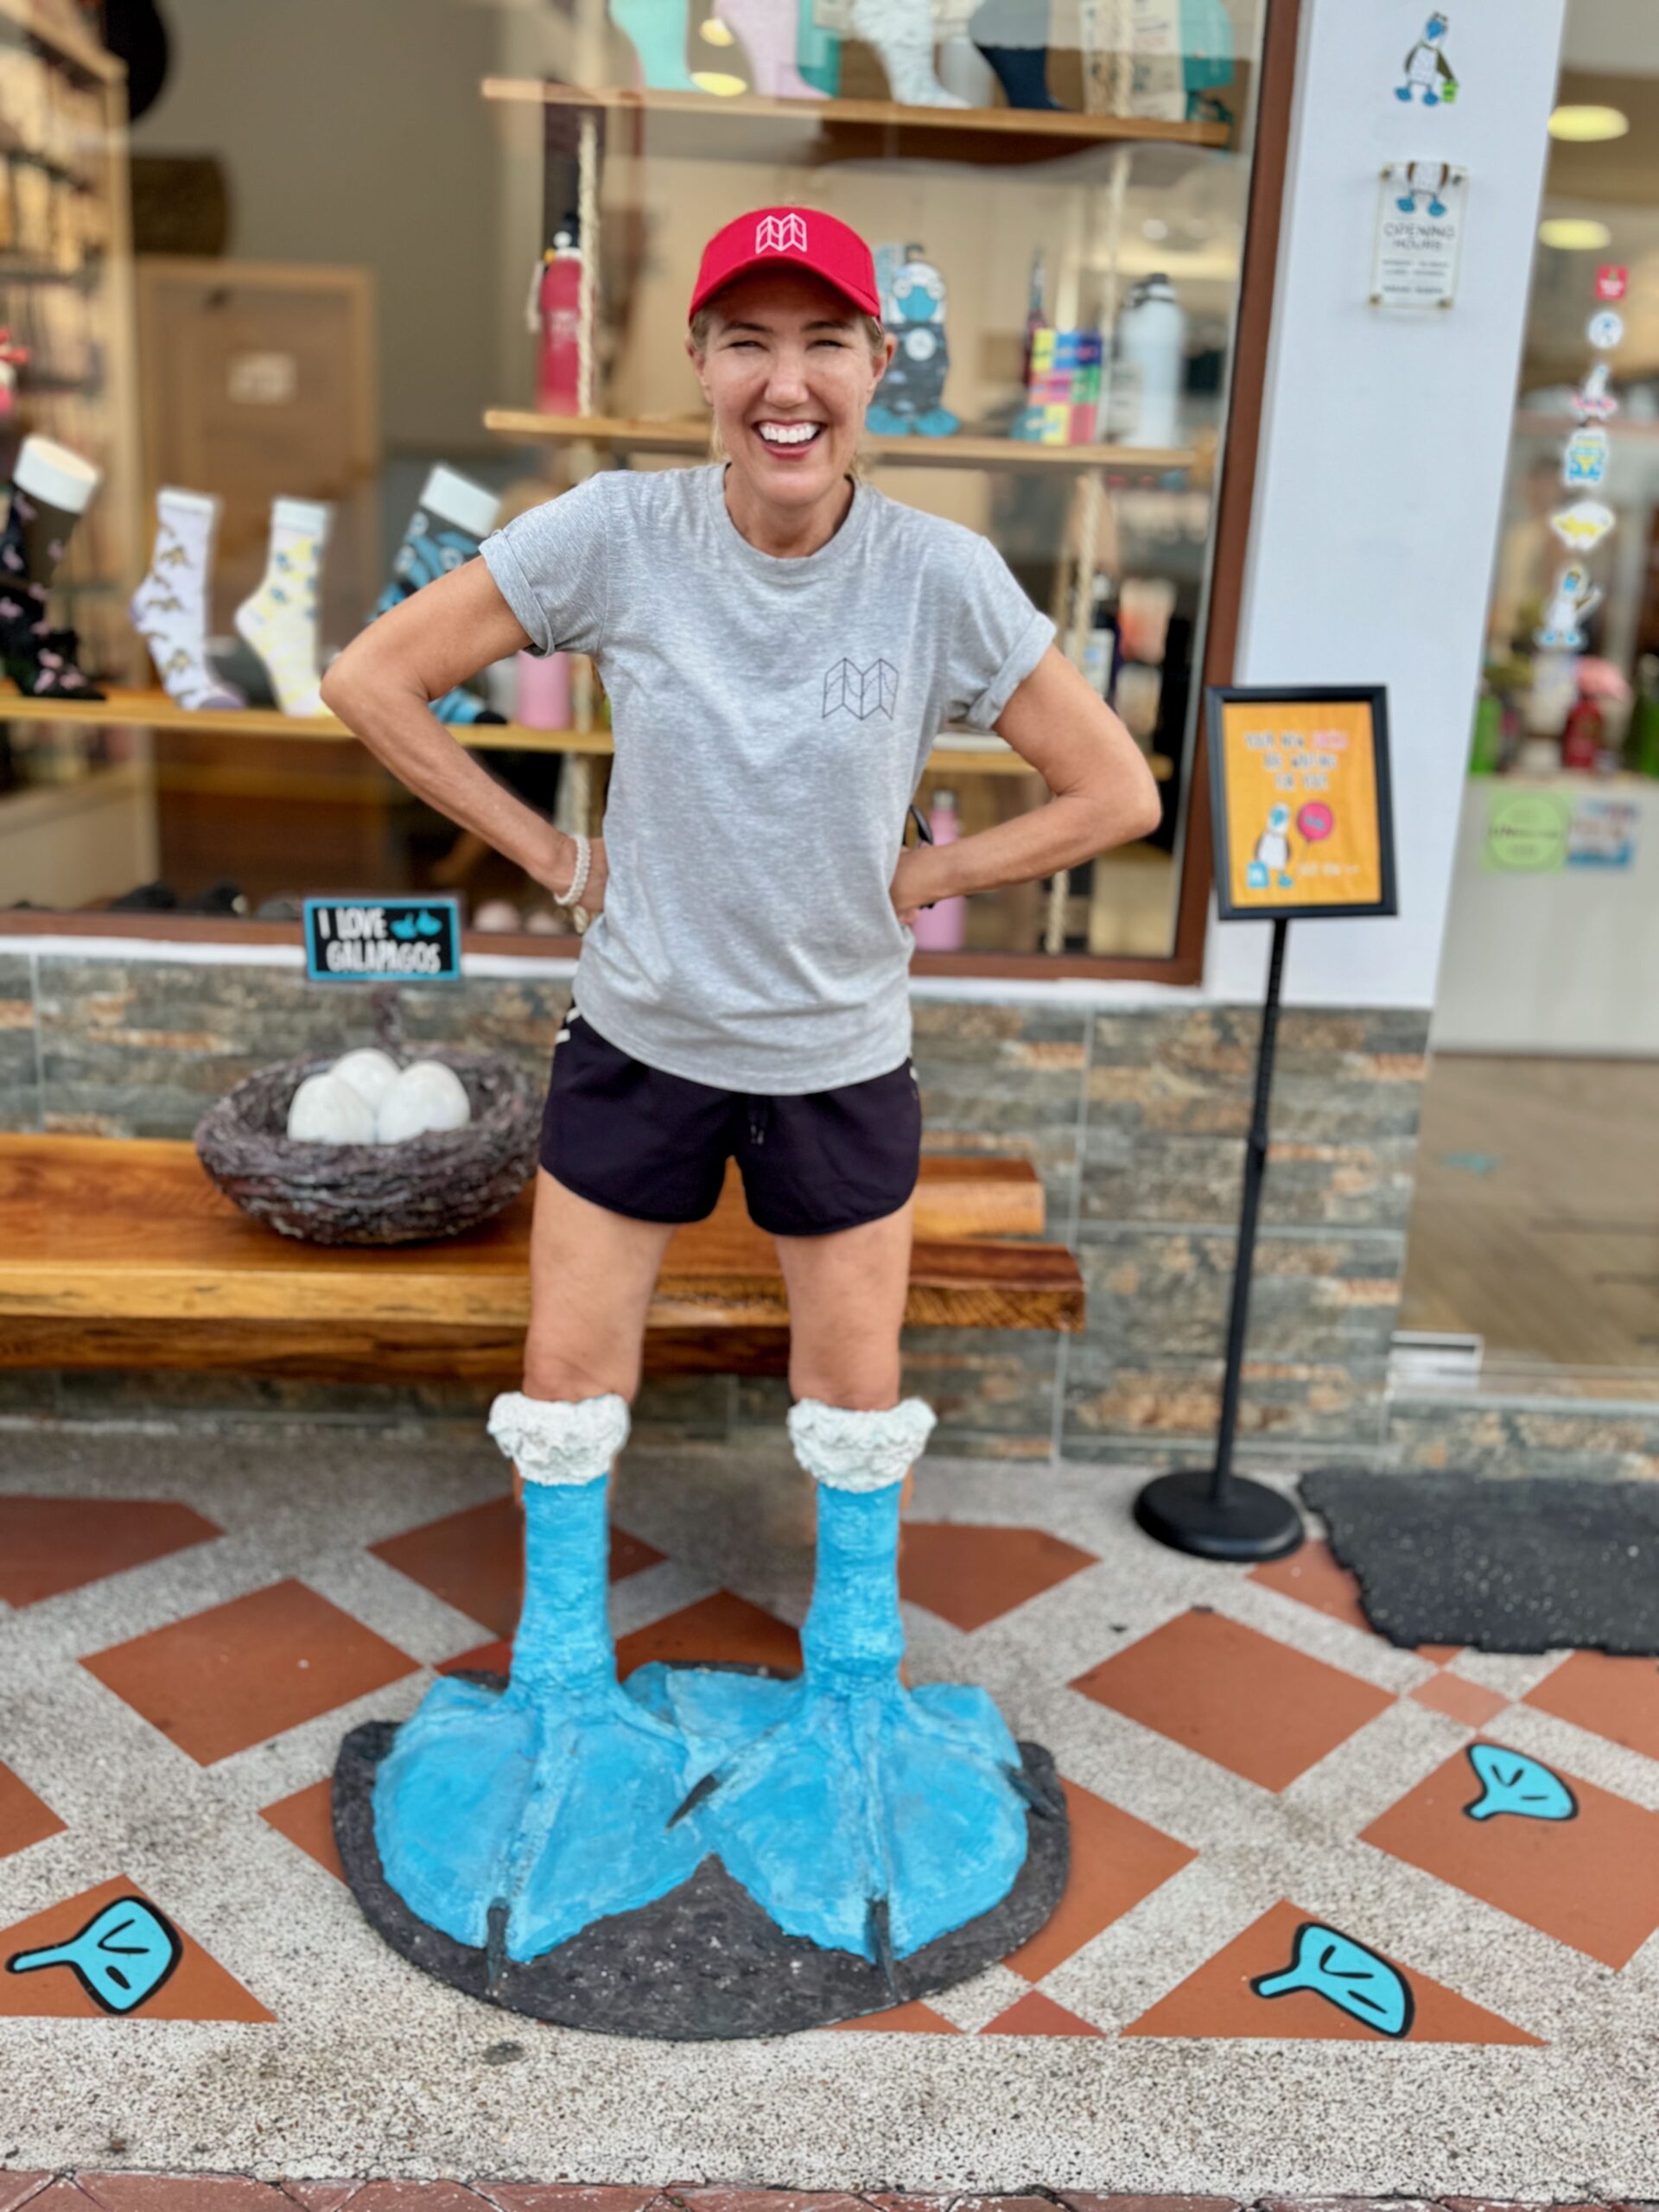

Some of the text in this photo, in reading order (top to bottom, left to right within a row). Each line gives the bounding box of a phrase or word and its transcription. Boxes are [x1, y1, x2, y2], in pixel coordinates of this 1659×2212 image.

[317, 907, 388, 940] I LOVE
[326, 939, 442, 975] GALAPAGOS
